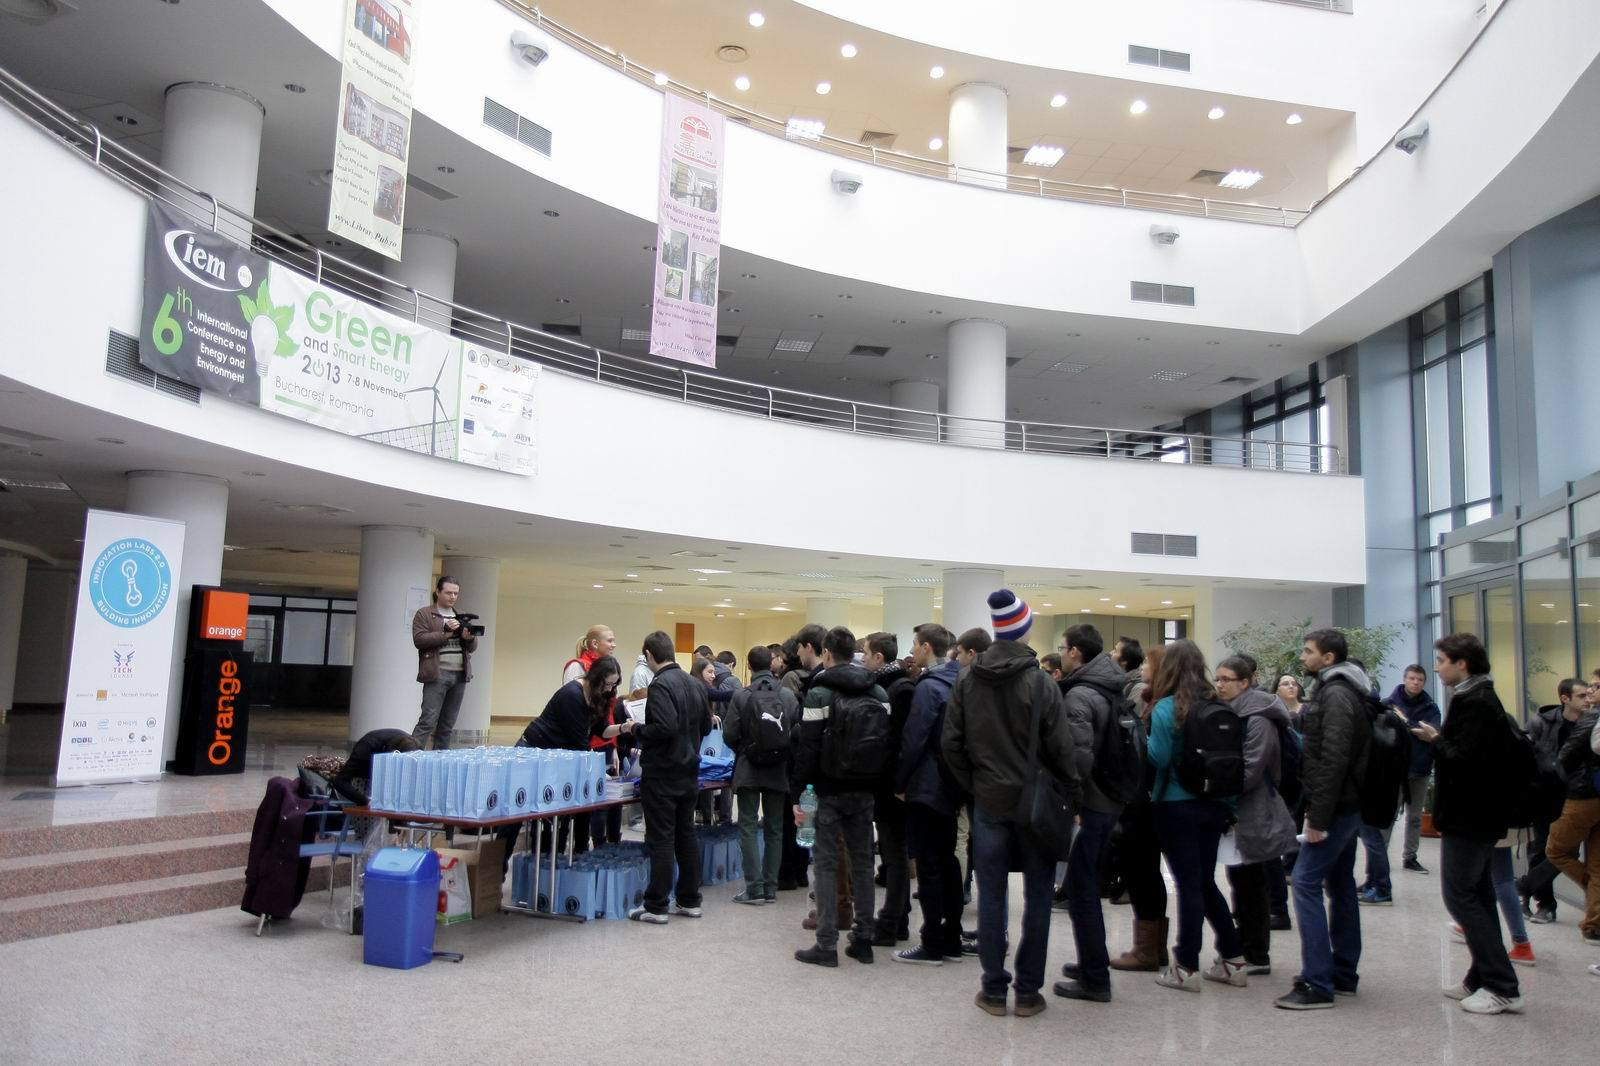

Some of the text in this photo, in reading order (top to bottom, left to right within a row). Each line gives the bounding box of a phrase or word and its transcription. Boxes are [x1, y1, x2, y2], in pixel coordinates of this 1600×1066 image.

[183, 236, 226, 281] iem
[187, 321, 246, 355] Conference on
[197, 309, 248, 341] International
[305, 290, 413, 365] Green
[197, 356, 245, 384] Environment
[200, 342, 246, 369] Energy and
[301, 354, 341, 384] 2013
[303, 335, 410, 384] and Smart Energy
[329, 394, 375, 418] Romania
[93, 541, 166, 584] INNOVATION LABS 2.0
[131, 583, 168, 624] INNOVATION
[208, 625, 243, 639] orange
[208, 659, 242, 766] Orange
